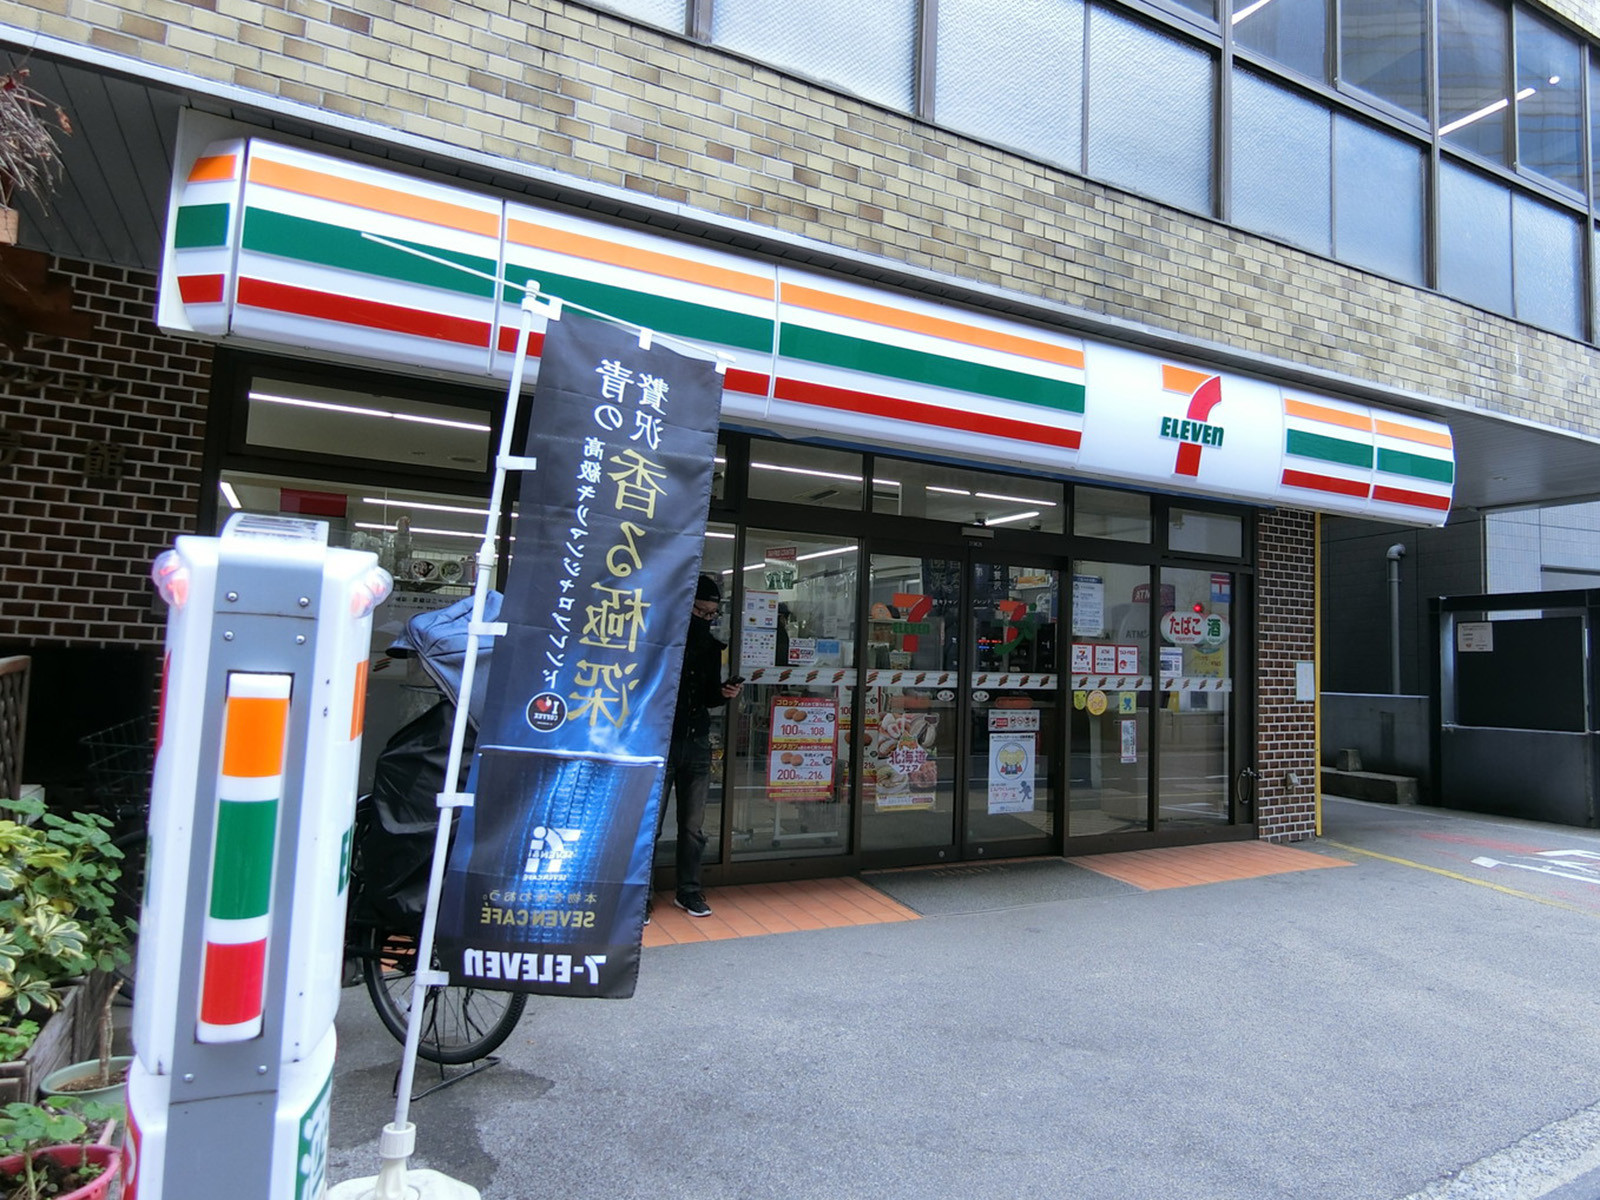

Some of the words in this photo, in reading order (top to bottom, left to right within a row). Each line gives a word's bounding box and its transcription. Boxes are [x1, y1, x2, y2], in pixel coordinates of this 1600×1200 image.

[1169, 615, 1202, 635] たばこ
[1207, 618, 1221, 637] 酒
[888, 750, 926, 765] 北海道
[898, 764, 919, 773] フェア
